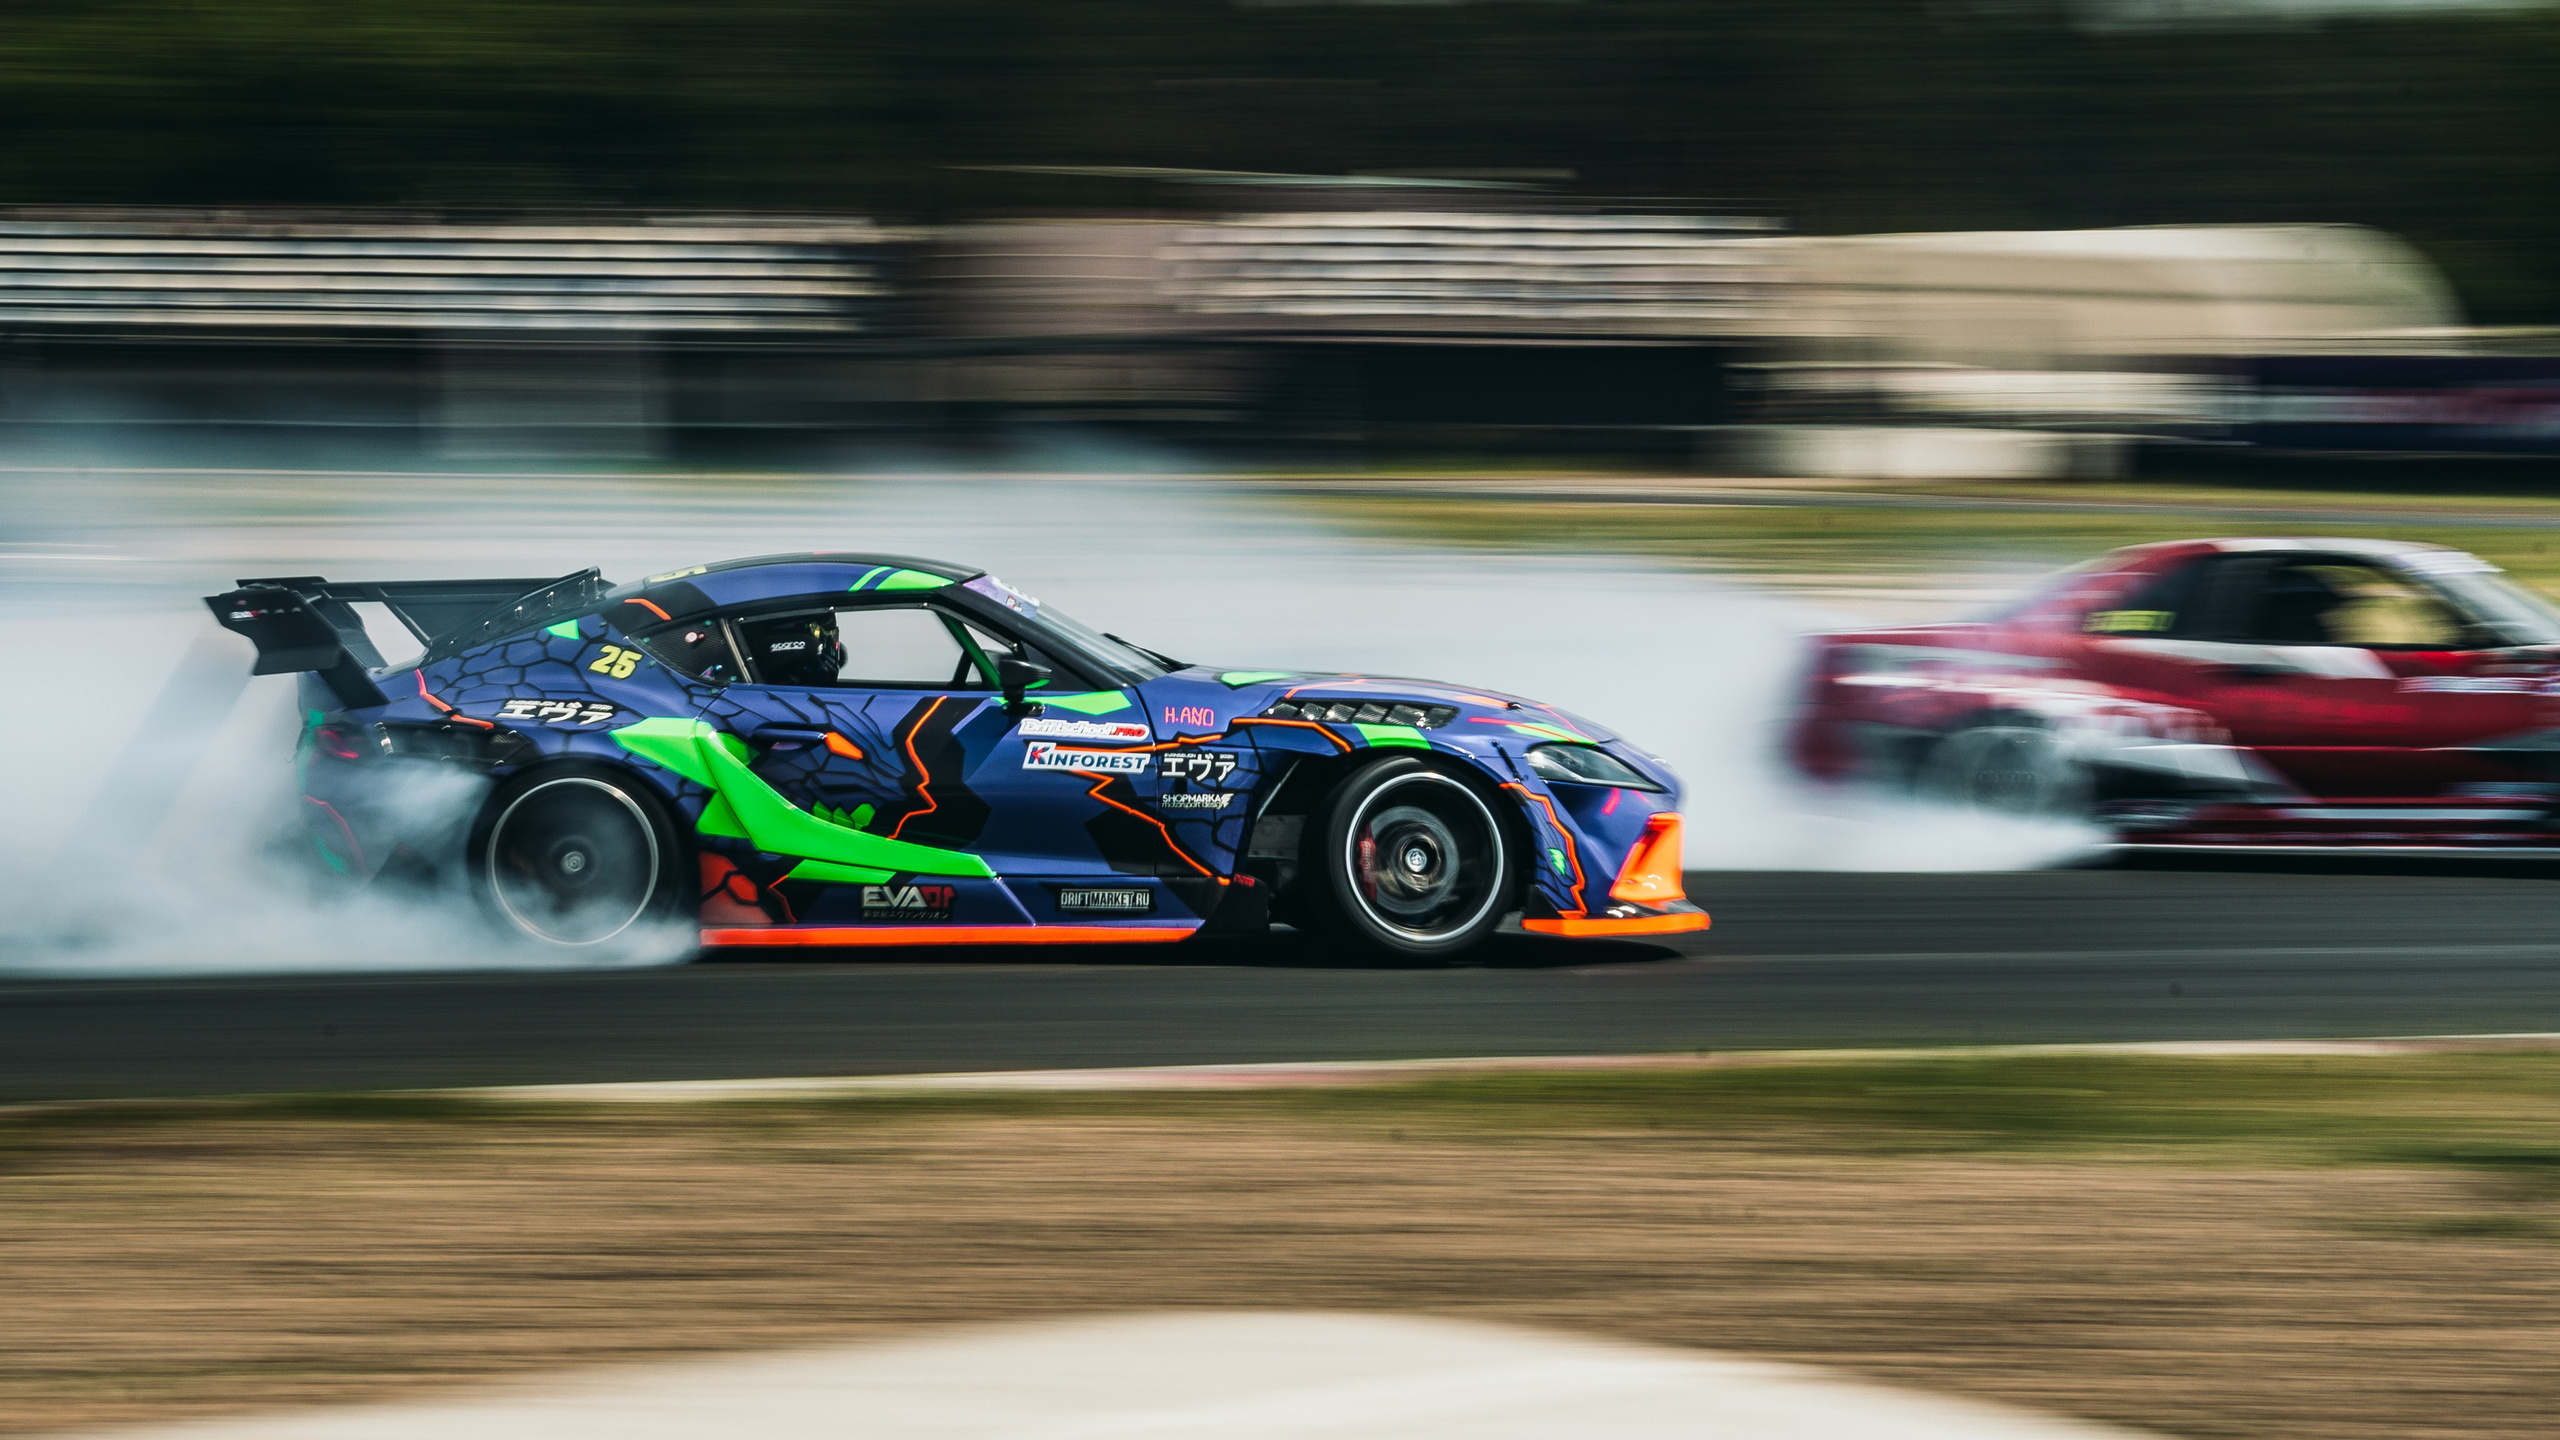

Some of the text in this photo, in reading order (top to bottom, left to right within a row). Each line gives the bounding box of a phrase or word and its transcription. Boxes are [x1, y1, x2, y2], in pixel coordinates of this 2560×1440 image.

[588, 644, 643, 680] 25
[494, 699, 613, 726] エヴァ
[1027, 745, 1146, 769] KINFOREST
[1161, 752, 1236, 782] エヴァ
[1162, 793, 1221, 803] SHOPMARKA
